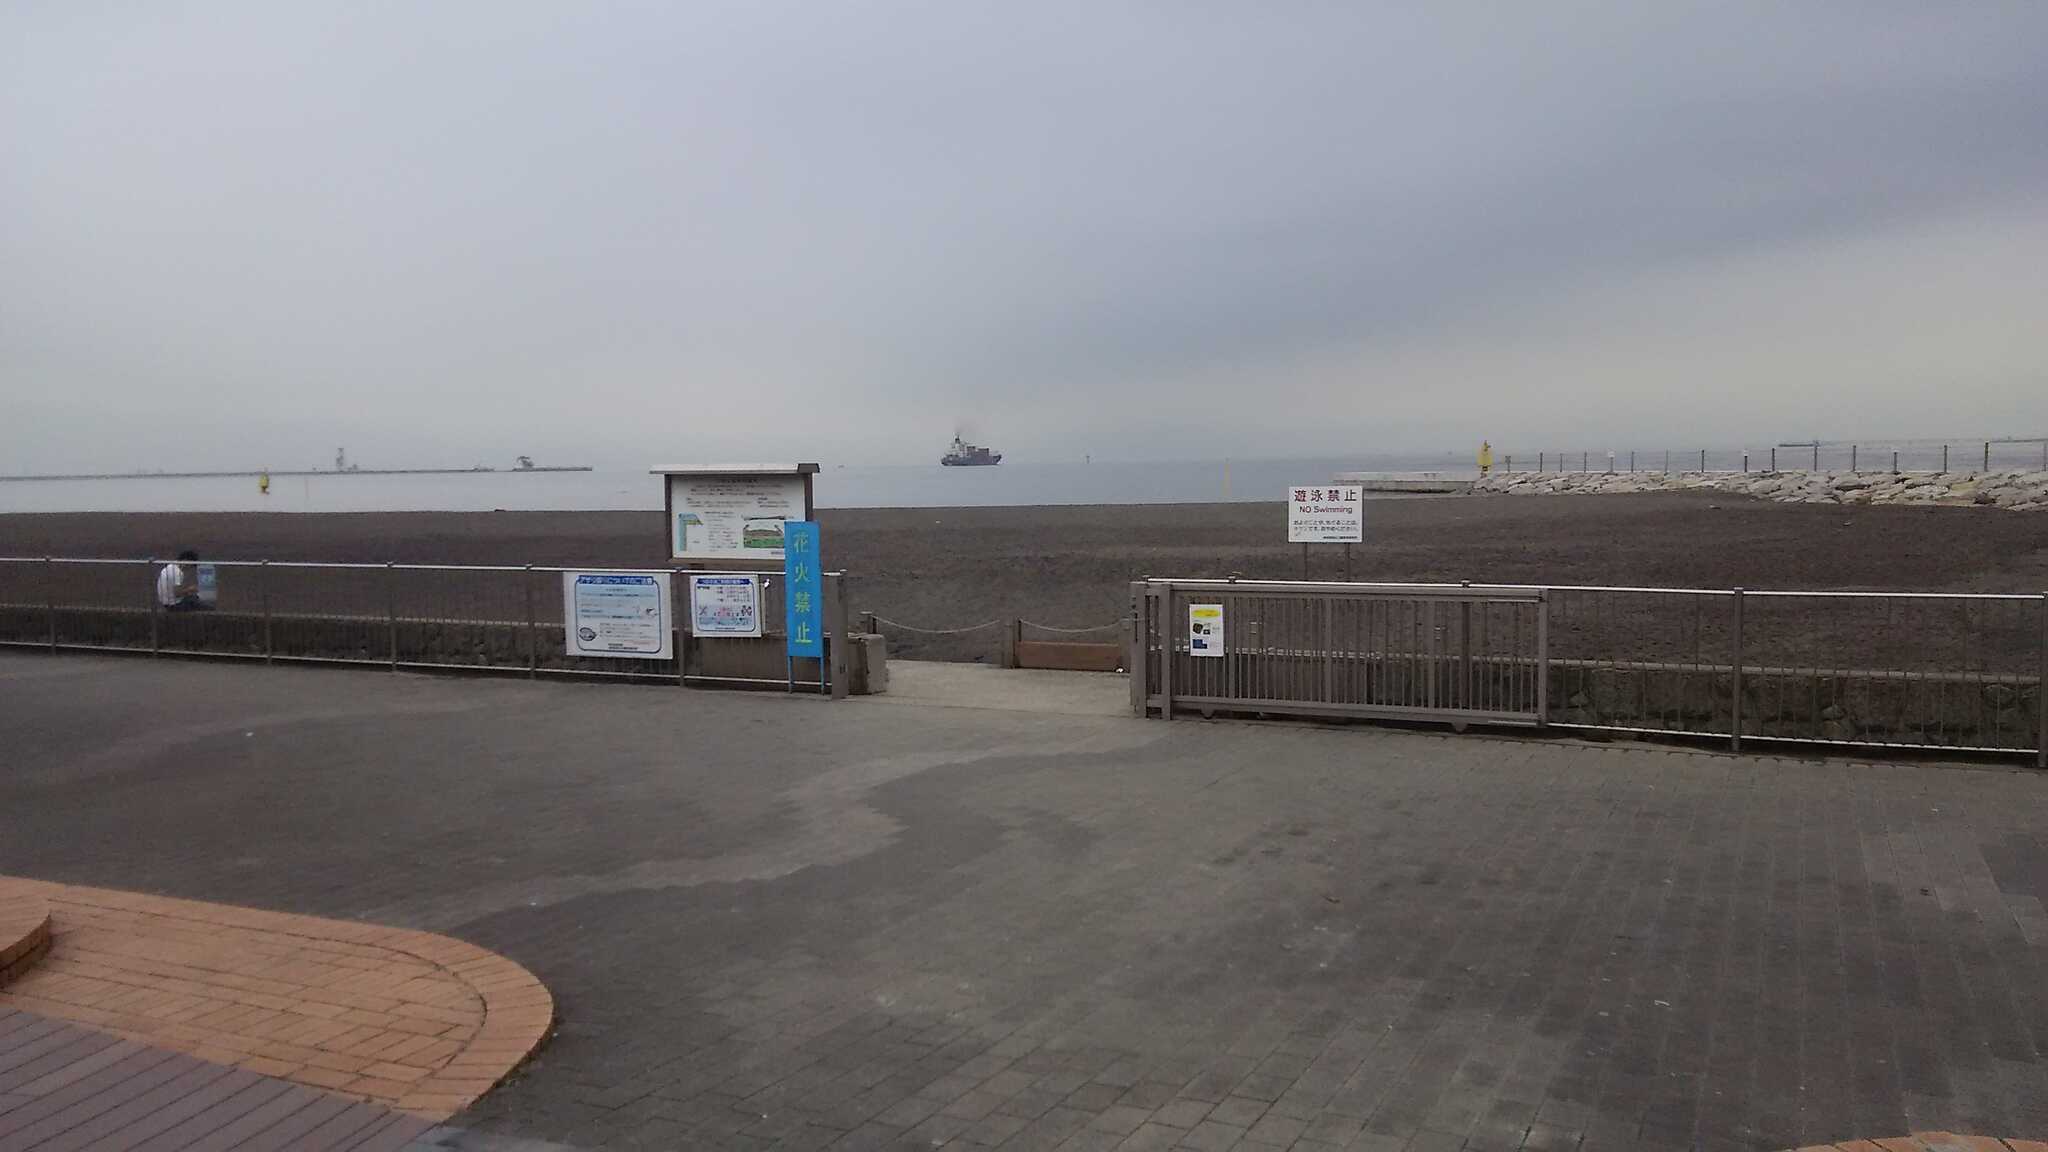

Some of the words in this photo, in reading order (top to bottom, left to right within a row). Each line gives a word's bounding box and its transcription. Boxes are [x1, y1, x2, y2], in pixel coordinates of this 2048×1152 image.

[1294, 489, 1357, 502] 遊泳禁止
[1300, 505, 1311, 513] NO
[1314, 505, 1353, 514] Swimming
[793, 531, 812, 644] 花火禁止
